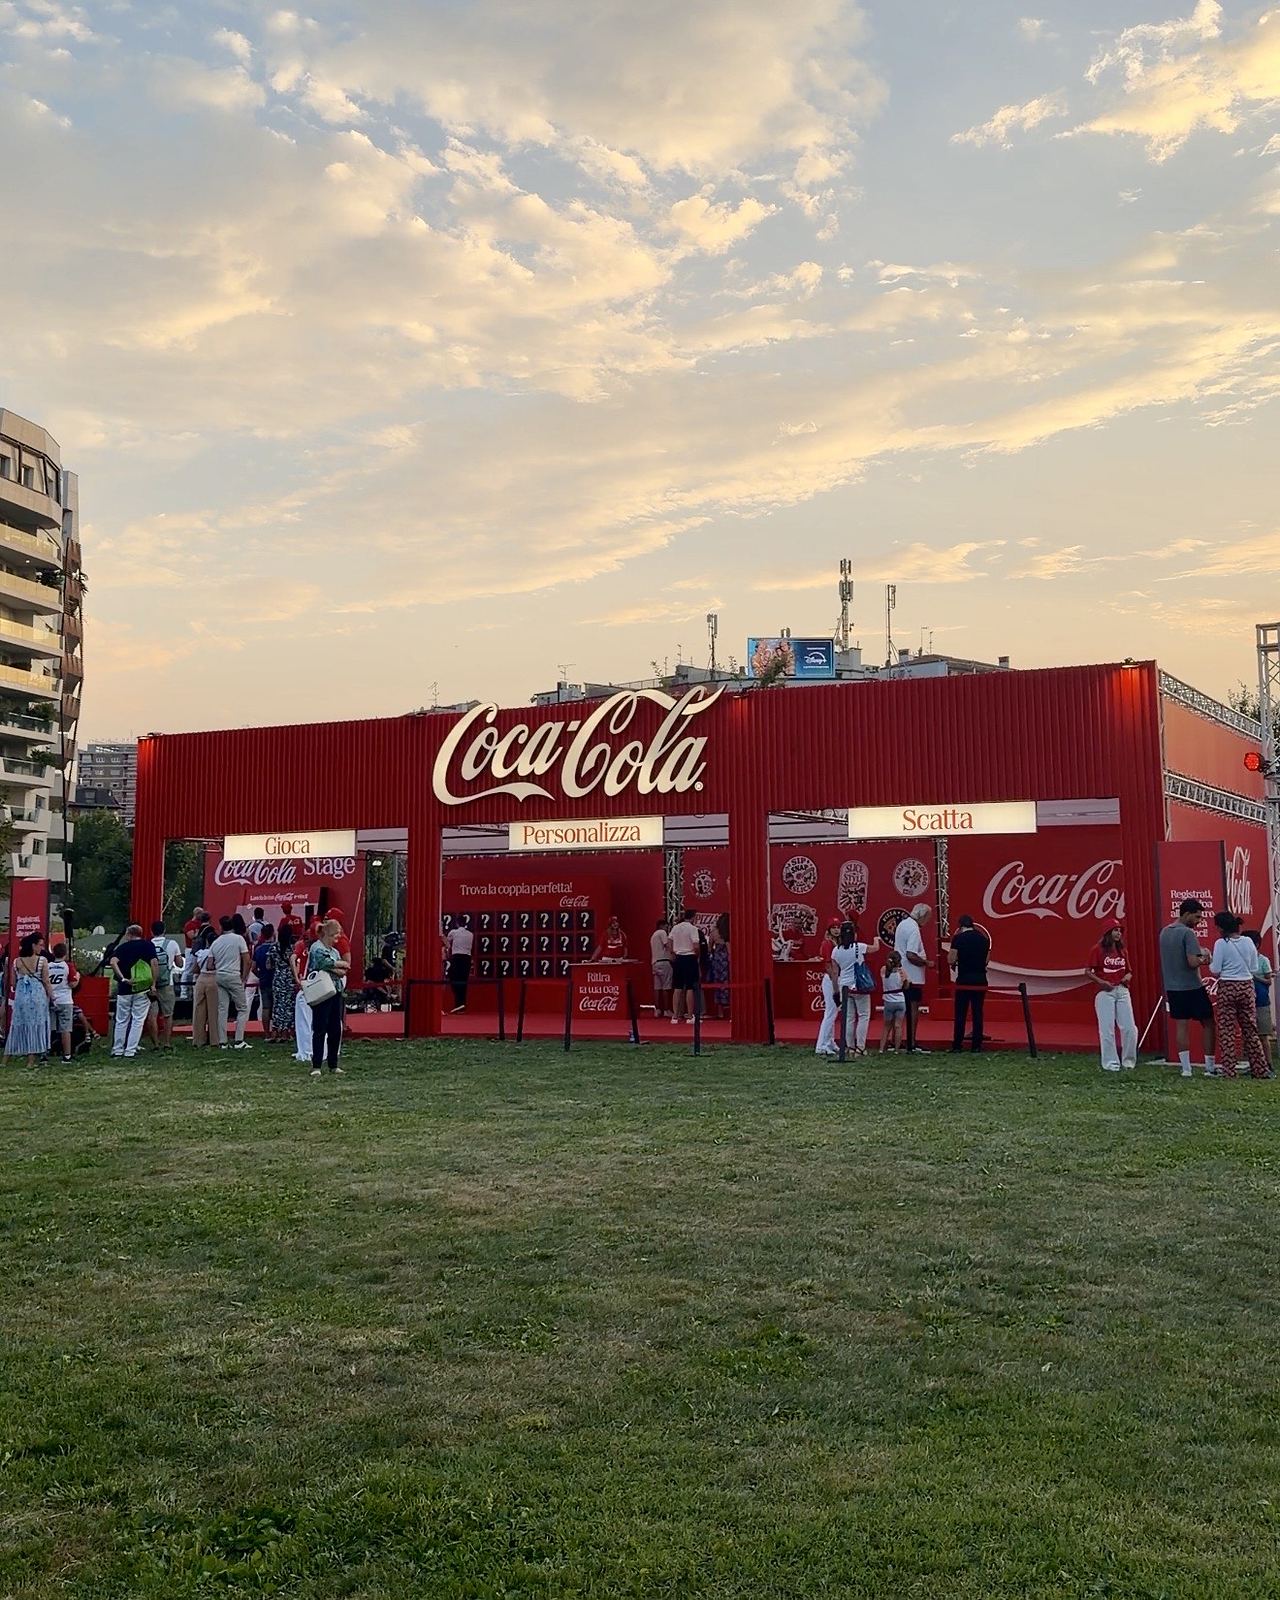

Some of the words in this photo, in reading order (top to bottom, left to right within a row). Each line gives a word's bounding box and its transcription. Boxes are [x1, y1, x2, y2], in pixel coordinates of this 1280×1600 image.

[432, 683, 727, 805] Coca-Cola
[902, 809, 973, 831] Scatta
[265, 836, 311, 856] Gioca
[522, 824, 642, 846] Personalizza
[303, 857, 356, 880] Stage
[460, 884, 487, 896] Trova
[488, 883, 497, 895] la
[498, 883, 530, 899] coppia
[531, 881, 573, 899] perfetta!
